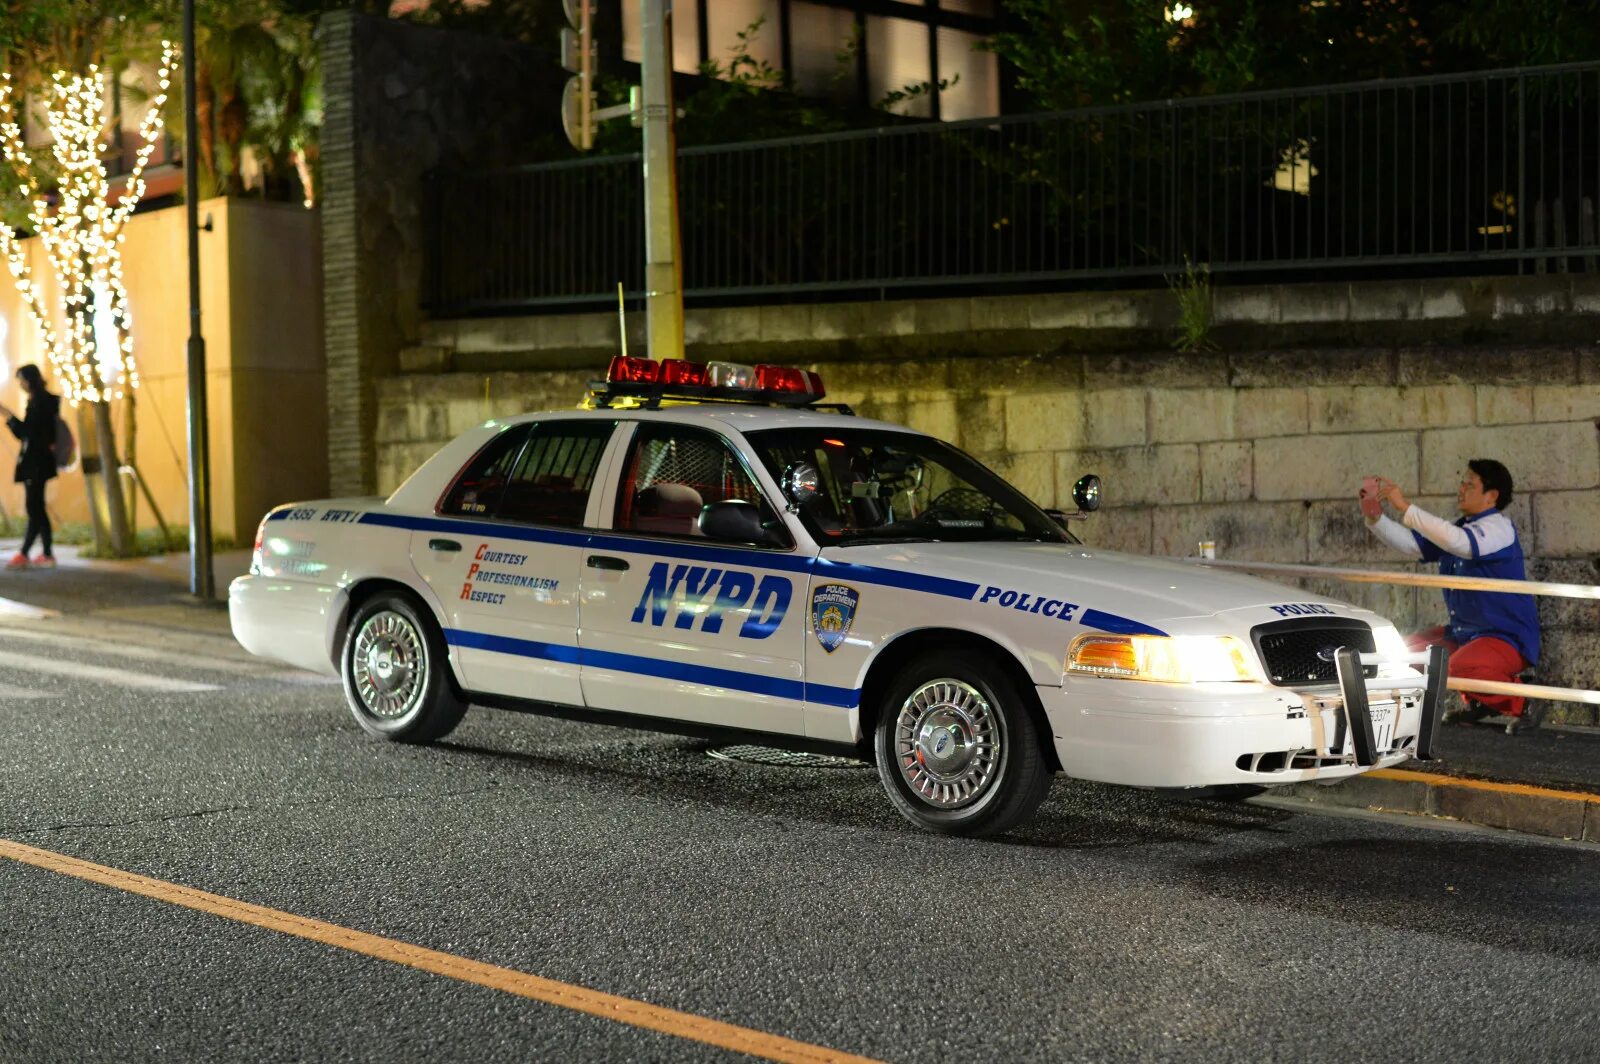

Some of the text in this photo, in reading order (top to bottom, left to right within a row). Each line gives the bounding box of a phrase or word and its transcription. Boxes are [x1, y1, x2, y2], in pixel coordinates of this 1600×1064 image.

[475, 544, 528, 565] COURTESY
[466, 563, 559, 590] PROFESSIONALISM
[460, 583, 506, 604] RESPECT
[631, 562, 793, 639] NYPD
[814, 594, 856, 608] DEPARTMENT
[826, 586, 848, 595] POLICE
[979, 586, 1079, 621] POLICE
[1269, 603, 1336, 617] POLICE
